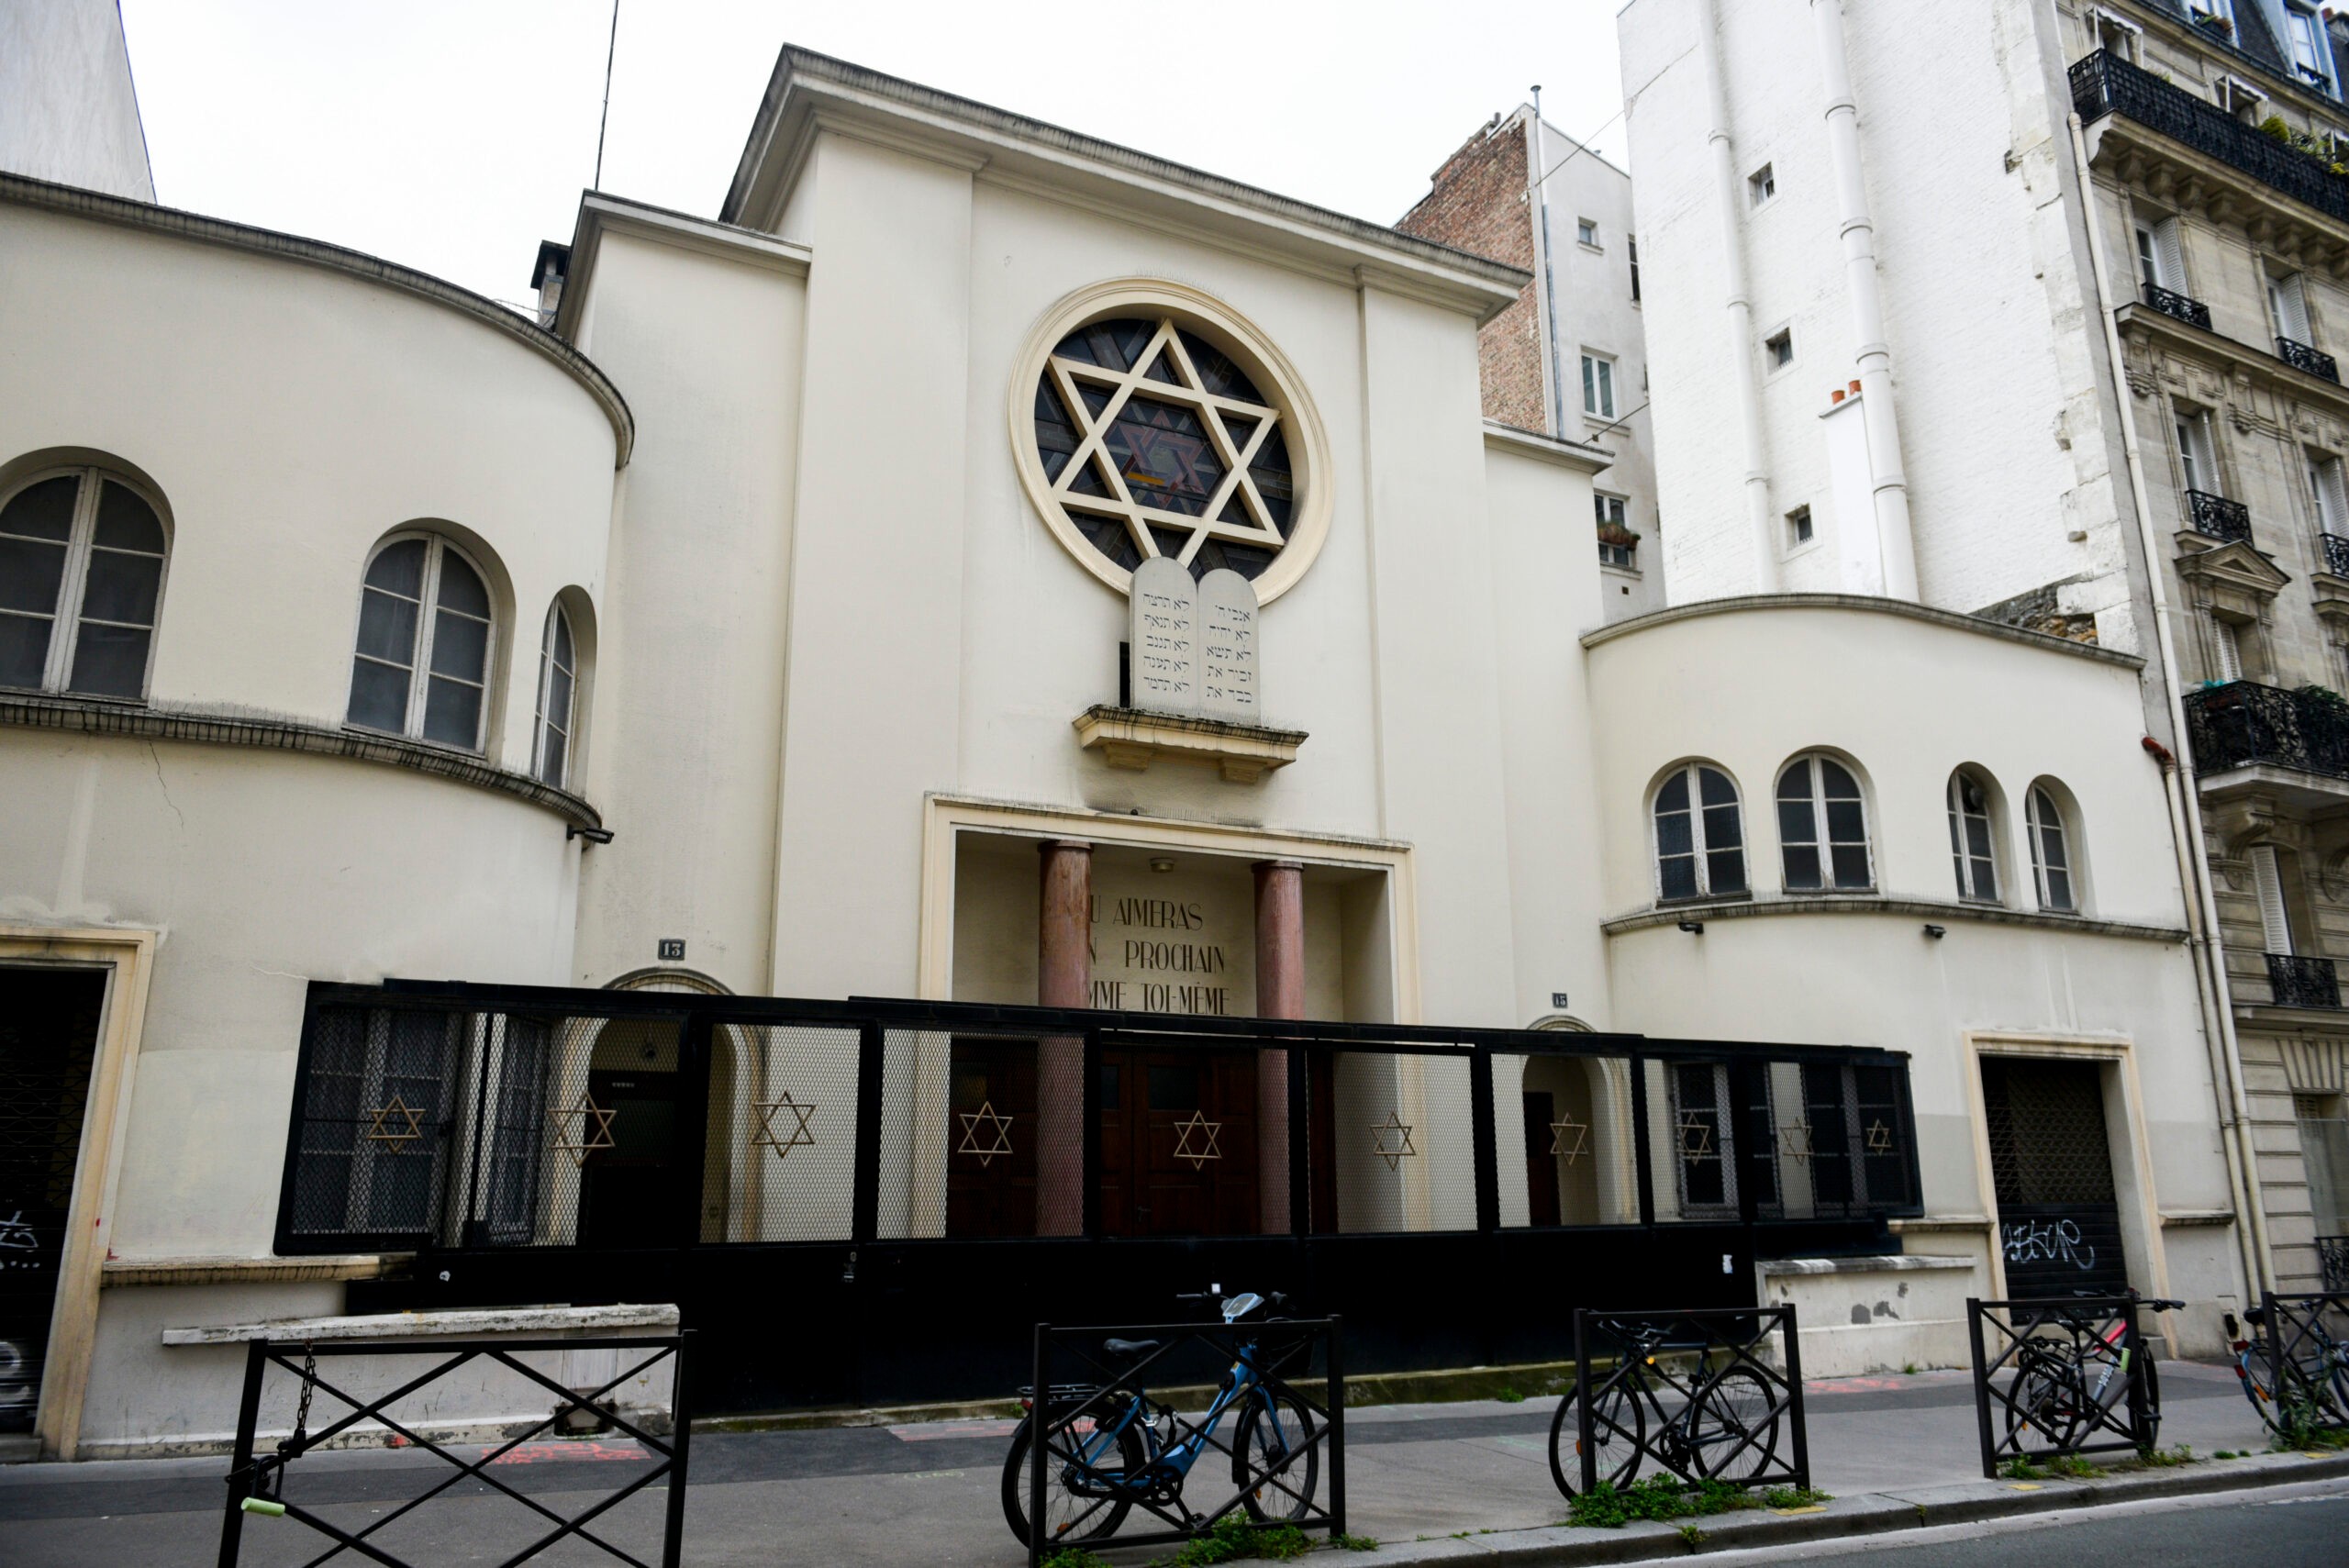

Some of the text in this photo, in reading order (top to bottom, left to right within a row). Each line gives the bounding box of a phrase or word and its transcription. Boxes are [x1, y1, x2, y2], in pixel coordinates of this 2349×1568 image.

[1174, 595, 1189, 611] לא
[1174, 616, 1189, 632] לא
[1174, 636, 1189, 652] לא
[1207, 645, 1252, 662] לא תשא
[1174, 655, 1189, 673] לא
[1208, 665, 1222, 678] את
[1174, 676, 1189, 694] לא
[1207, 685, 1222, 698] את
[1089, 895, 1203, 931] U AIMERAS
[662, 942, 682, 957] 13
[1125, 940, 1225, 973] PROCHAIN
[1089, 980, 1127, 1010] MME
